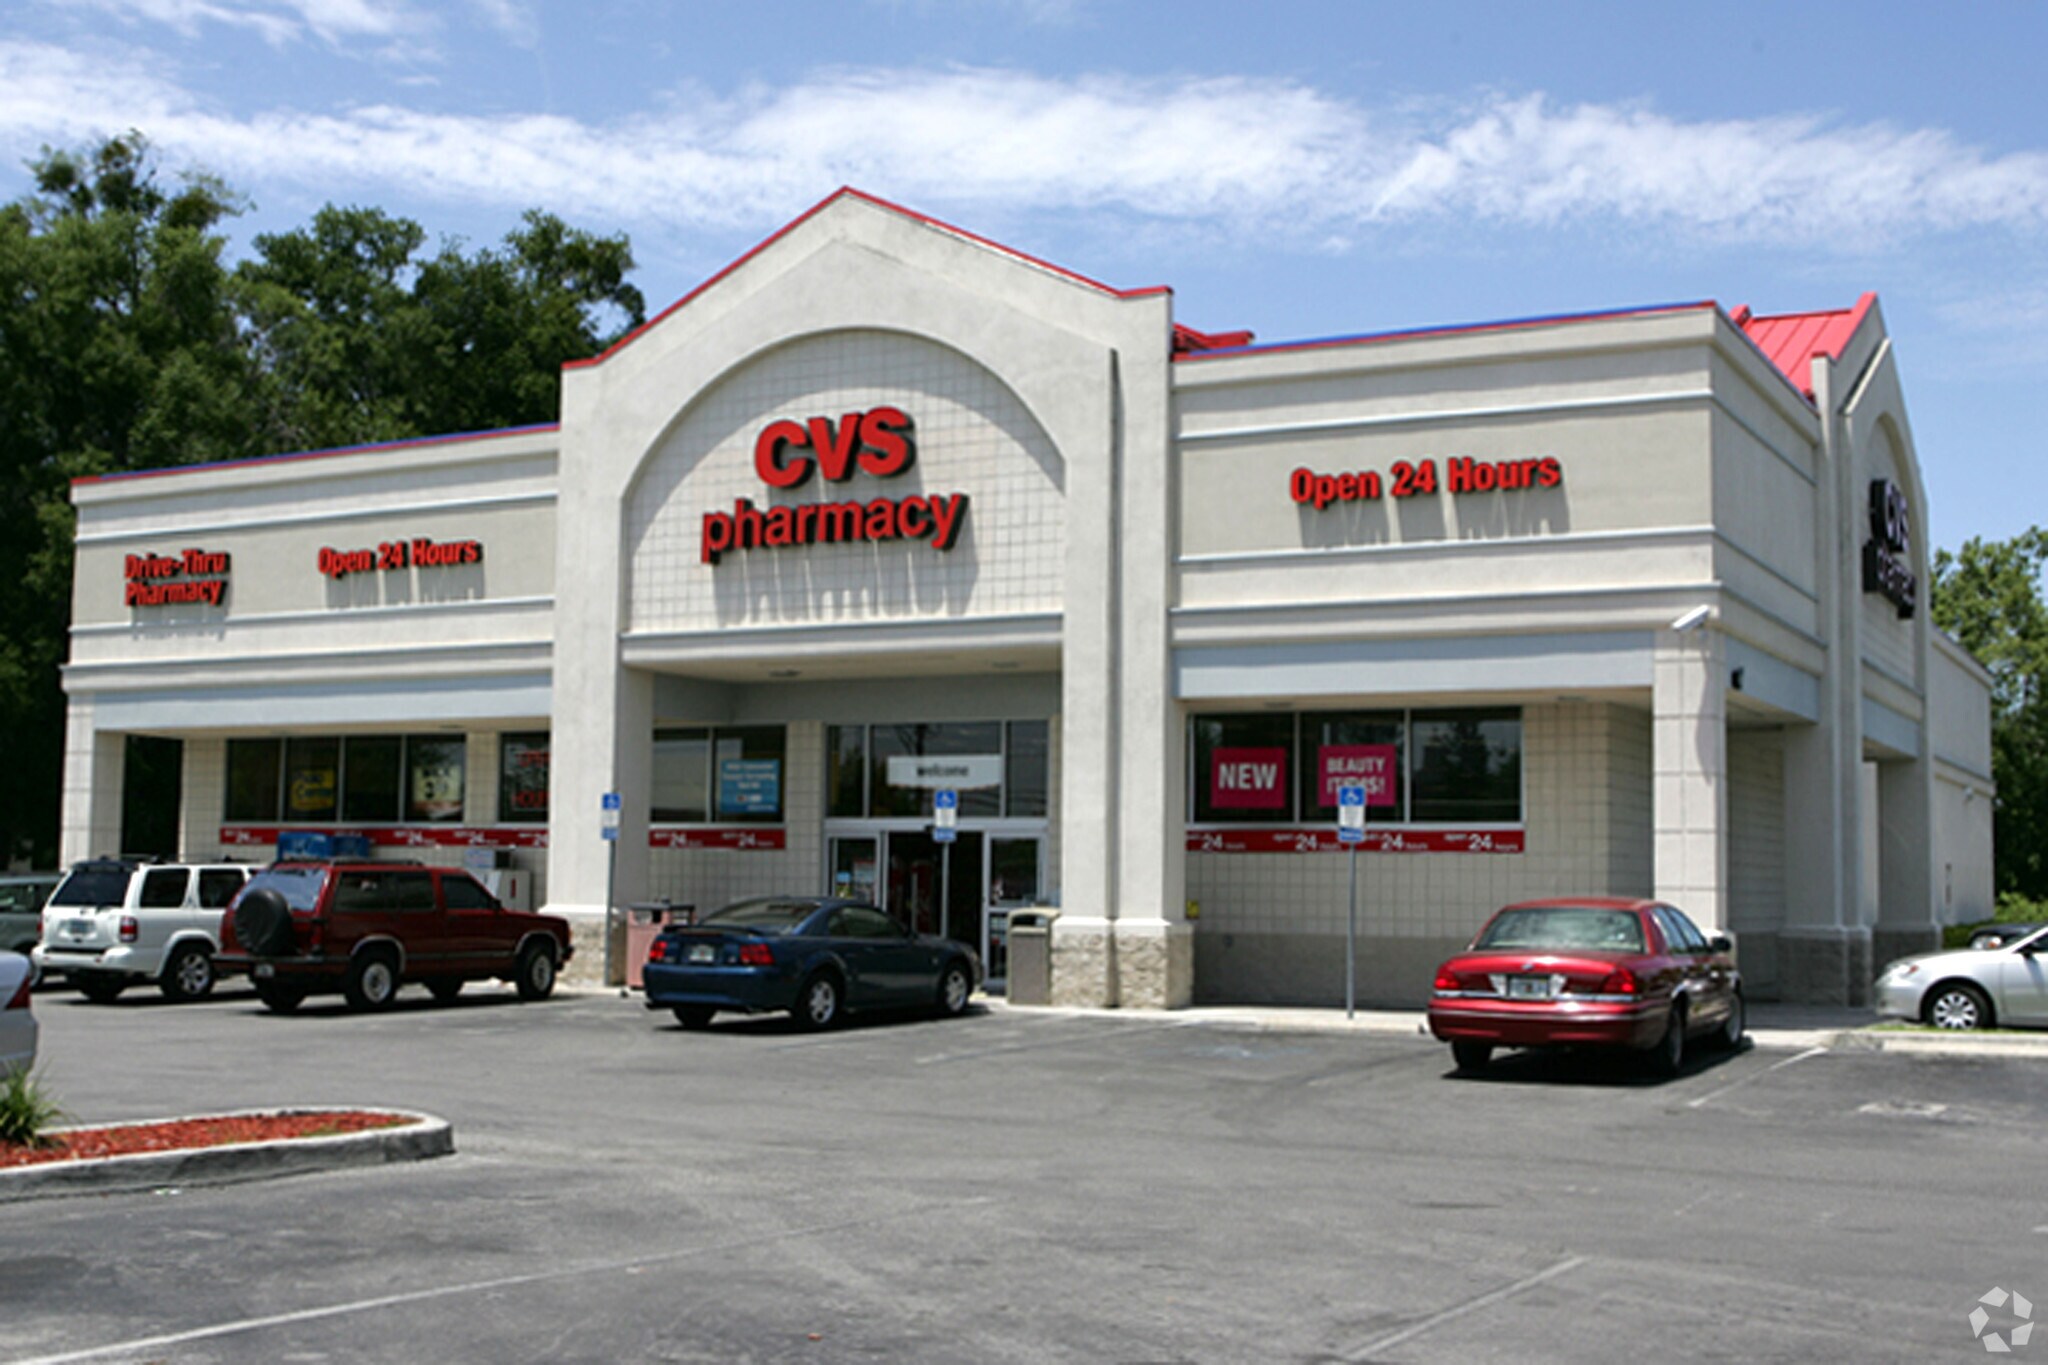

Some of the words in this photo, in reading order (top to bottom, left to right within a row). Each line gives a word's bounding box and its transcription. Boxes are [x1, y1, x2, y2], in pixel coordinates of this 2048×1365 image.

[755, 406, 914, 488] CVS
[1290, 467, 1381, 509] Open
[1390, 459, 1437, 497] 24
[1447, 457, 1562, 493] Hours
[702, 494, 966, 565] pharmacy
[125, 549, 229, 579] Drive-Thru
[318, 546, 375, 578] Open
[377, 541, 407, 569] 24
[411, 538, 482, 566] Hours
[125, 580, 226, 606] Pharmacy
[917, 763, 969, 778] welcome
[1218, 763, 1278, 790] NEW
[1326, 757, 1386, 773] BEAUTY
[1201, 832, 1223, 850] 24
[1295, 832, 1317, 850] 24
[1380, 832, 1404, 850] 24
[1468, 833, 1492, 850] 24
